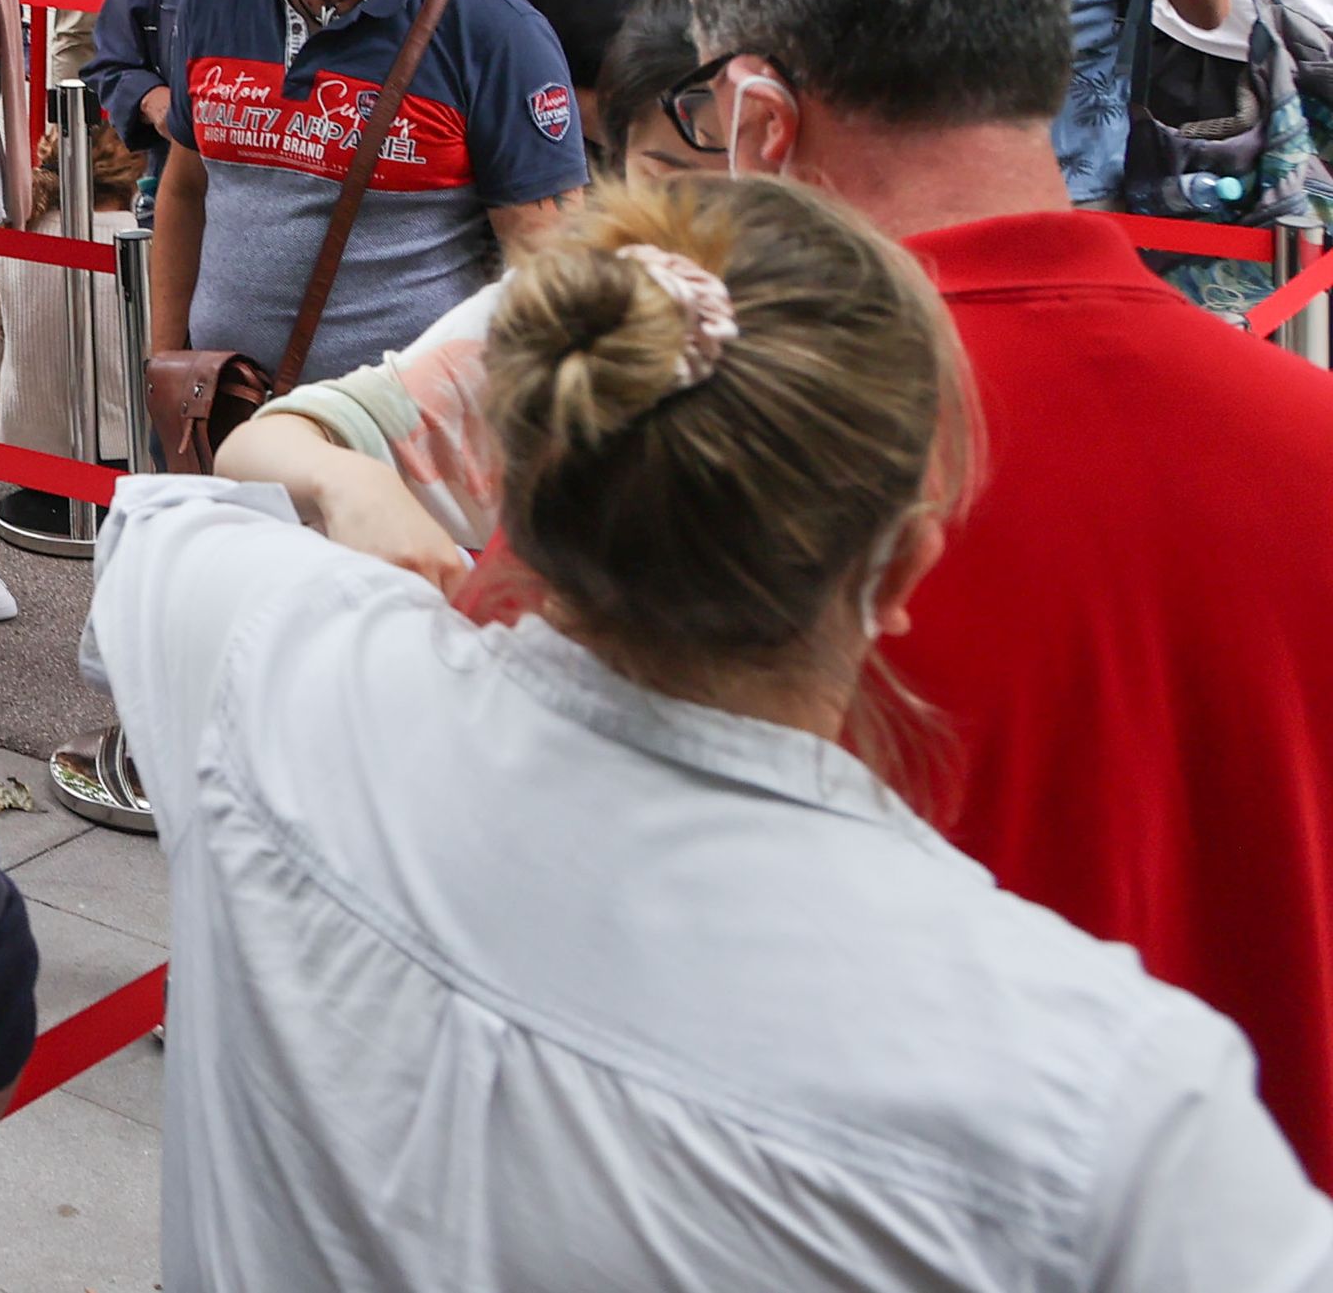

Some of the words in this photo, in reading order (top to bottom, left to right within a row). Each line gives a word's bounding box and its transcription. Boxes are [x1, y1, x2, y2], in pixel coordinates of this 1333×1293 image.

[197, 65, 271, 104] Custom
[194, 99, 282, 132] QUALITY
[286, 111, 427, 165] APPAEL
[204, 125, 227, 143] HIGH
[230, 129, 279, 150] QUALITY
[283, 134, 325, 159] BRAND
